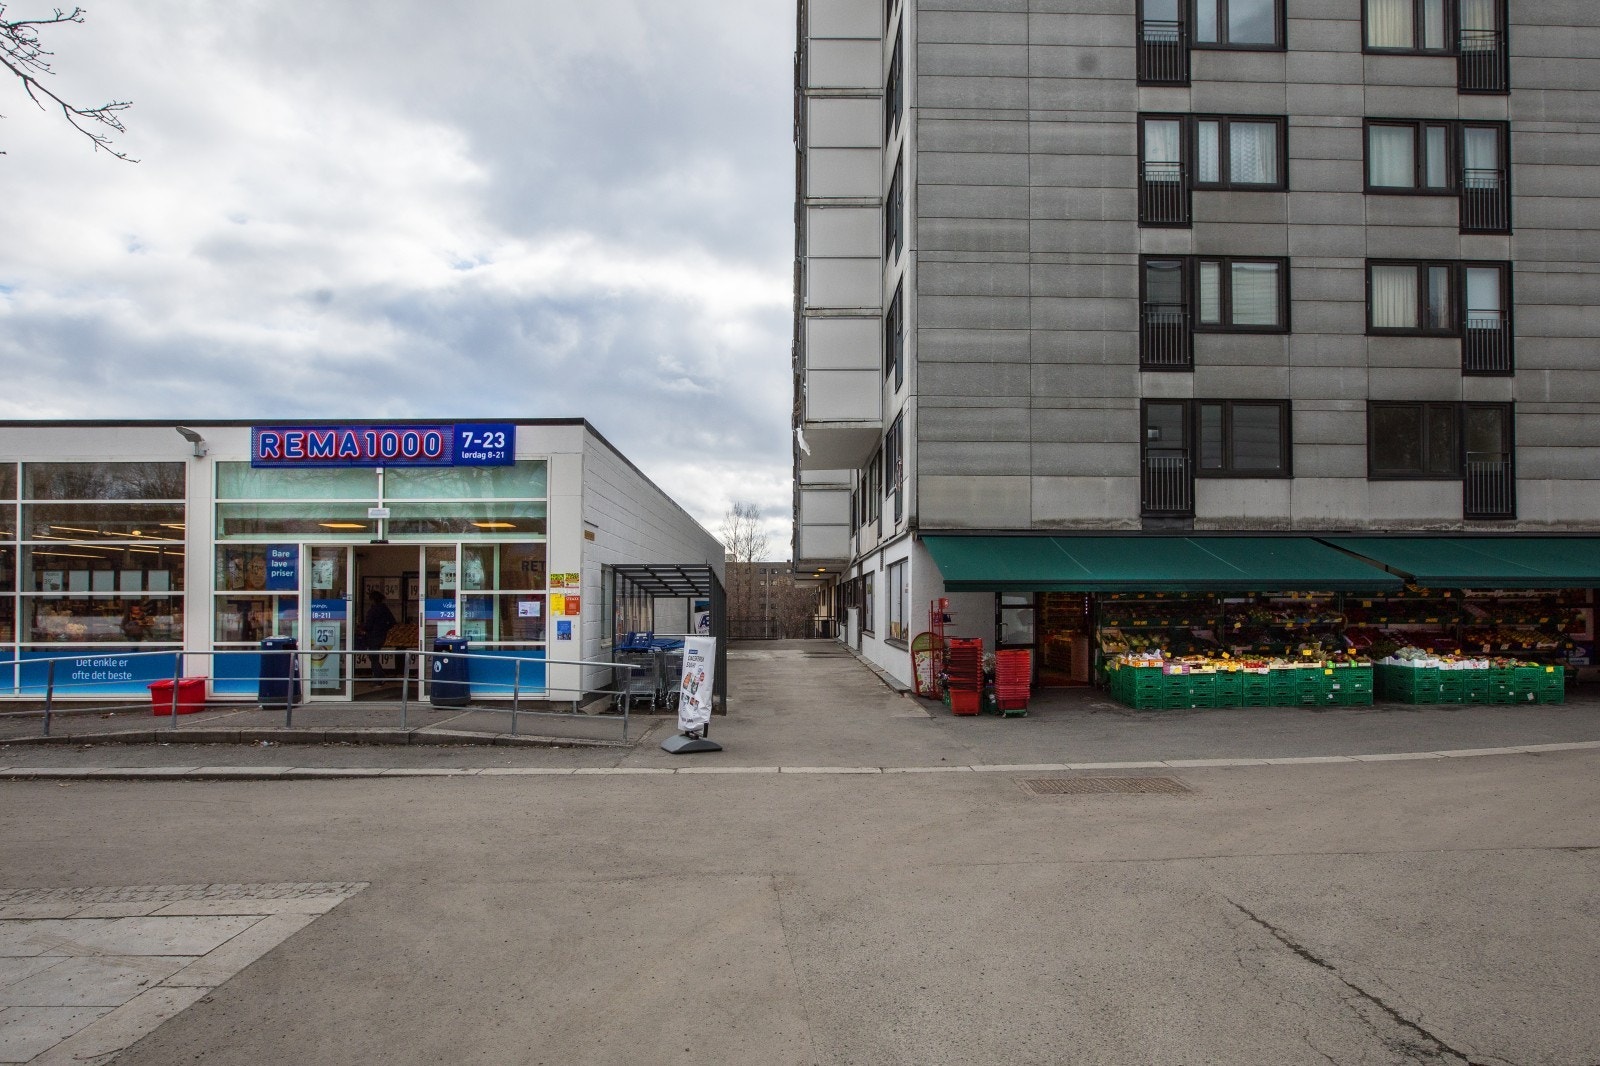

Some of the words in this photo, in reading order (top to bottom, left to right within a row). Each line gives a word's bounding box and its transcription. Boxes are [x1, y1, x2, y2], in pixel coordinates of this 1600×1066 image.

[259, 431, 361, 458] REMA
[365, 431, 443, 457] 1000
[462, 432, 505, 448] 7-23
[461, 451, 487, 459] lørdag
[488, 451, 505, 459] 8-21
[272, 549, 290, 558] Bare
[271, 559, 288, 568] lave
[271, 569, 294, 578] priser
[317, 629, 328, 643] 25
[93, 657, 118, 667] enkle
[118, 659, 128, 667] er
[72, 670, 91, 680] ofte
[91, 670, 107, 680] det
[107, 670, 133, 680] beste
